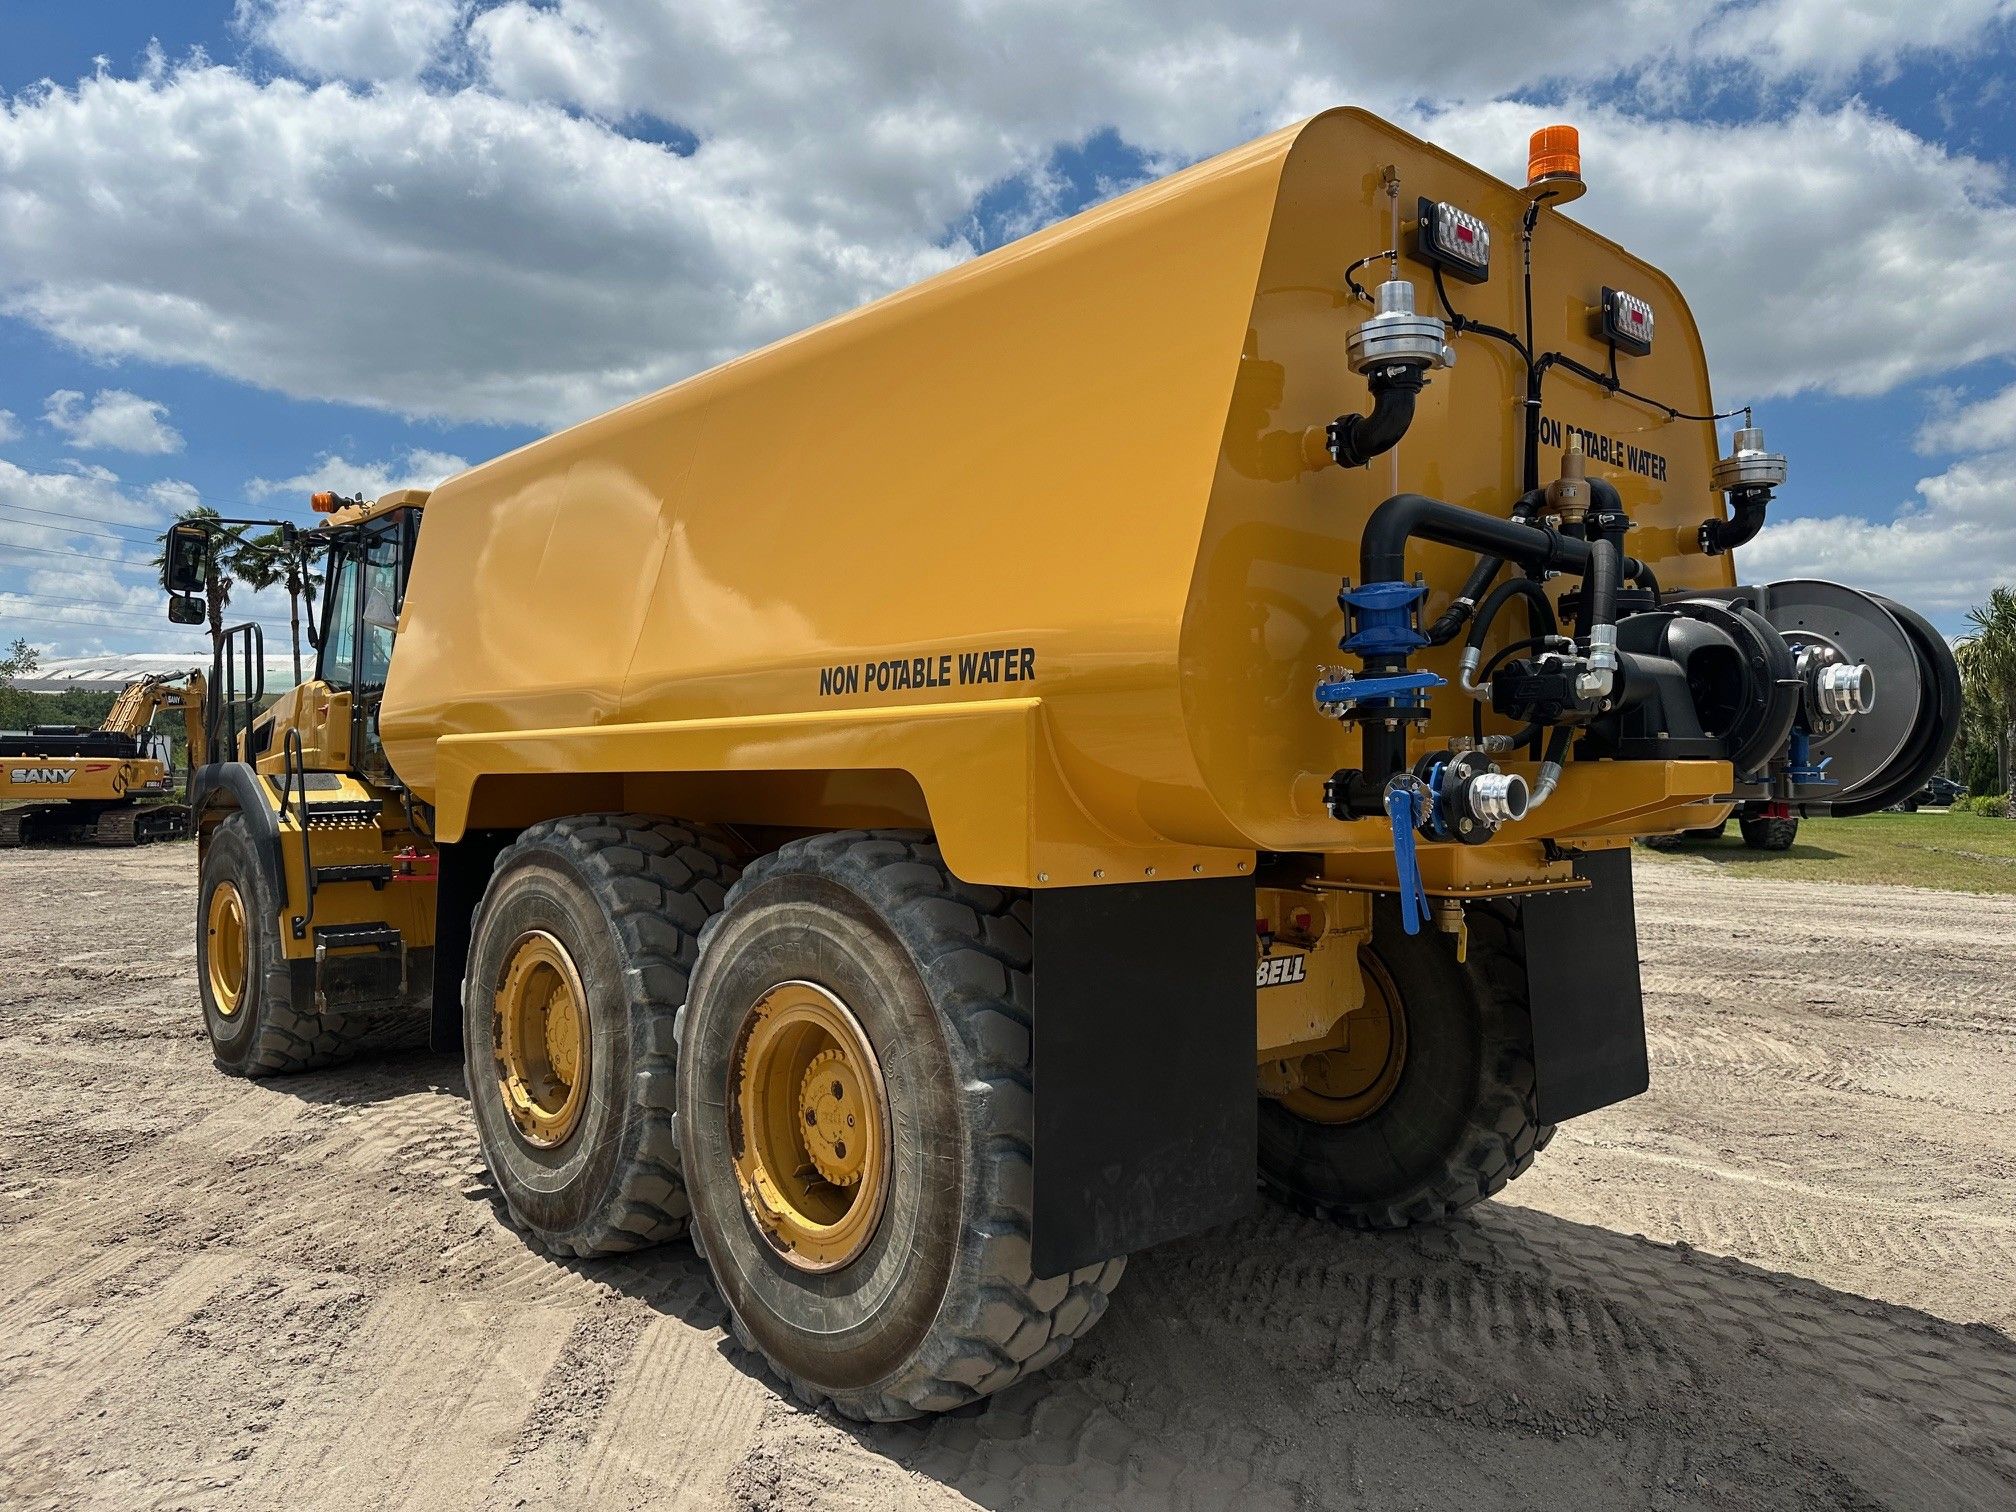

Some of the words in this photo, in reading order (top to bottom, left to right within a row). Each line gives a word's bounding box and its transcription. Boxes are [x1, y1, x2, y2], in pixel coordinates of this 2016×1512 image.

[1539, 416, 1561, 449] ON
[1627, 445, 1667, 482] WATER
[819, 664, 859, 696] NON
[864, 654, 952, 692] POTABLE
[958, 647, 1036, 685] WATER
[11, 768, 77, 784] SANY
[1256, 955, 1306, 988] BELL
